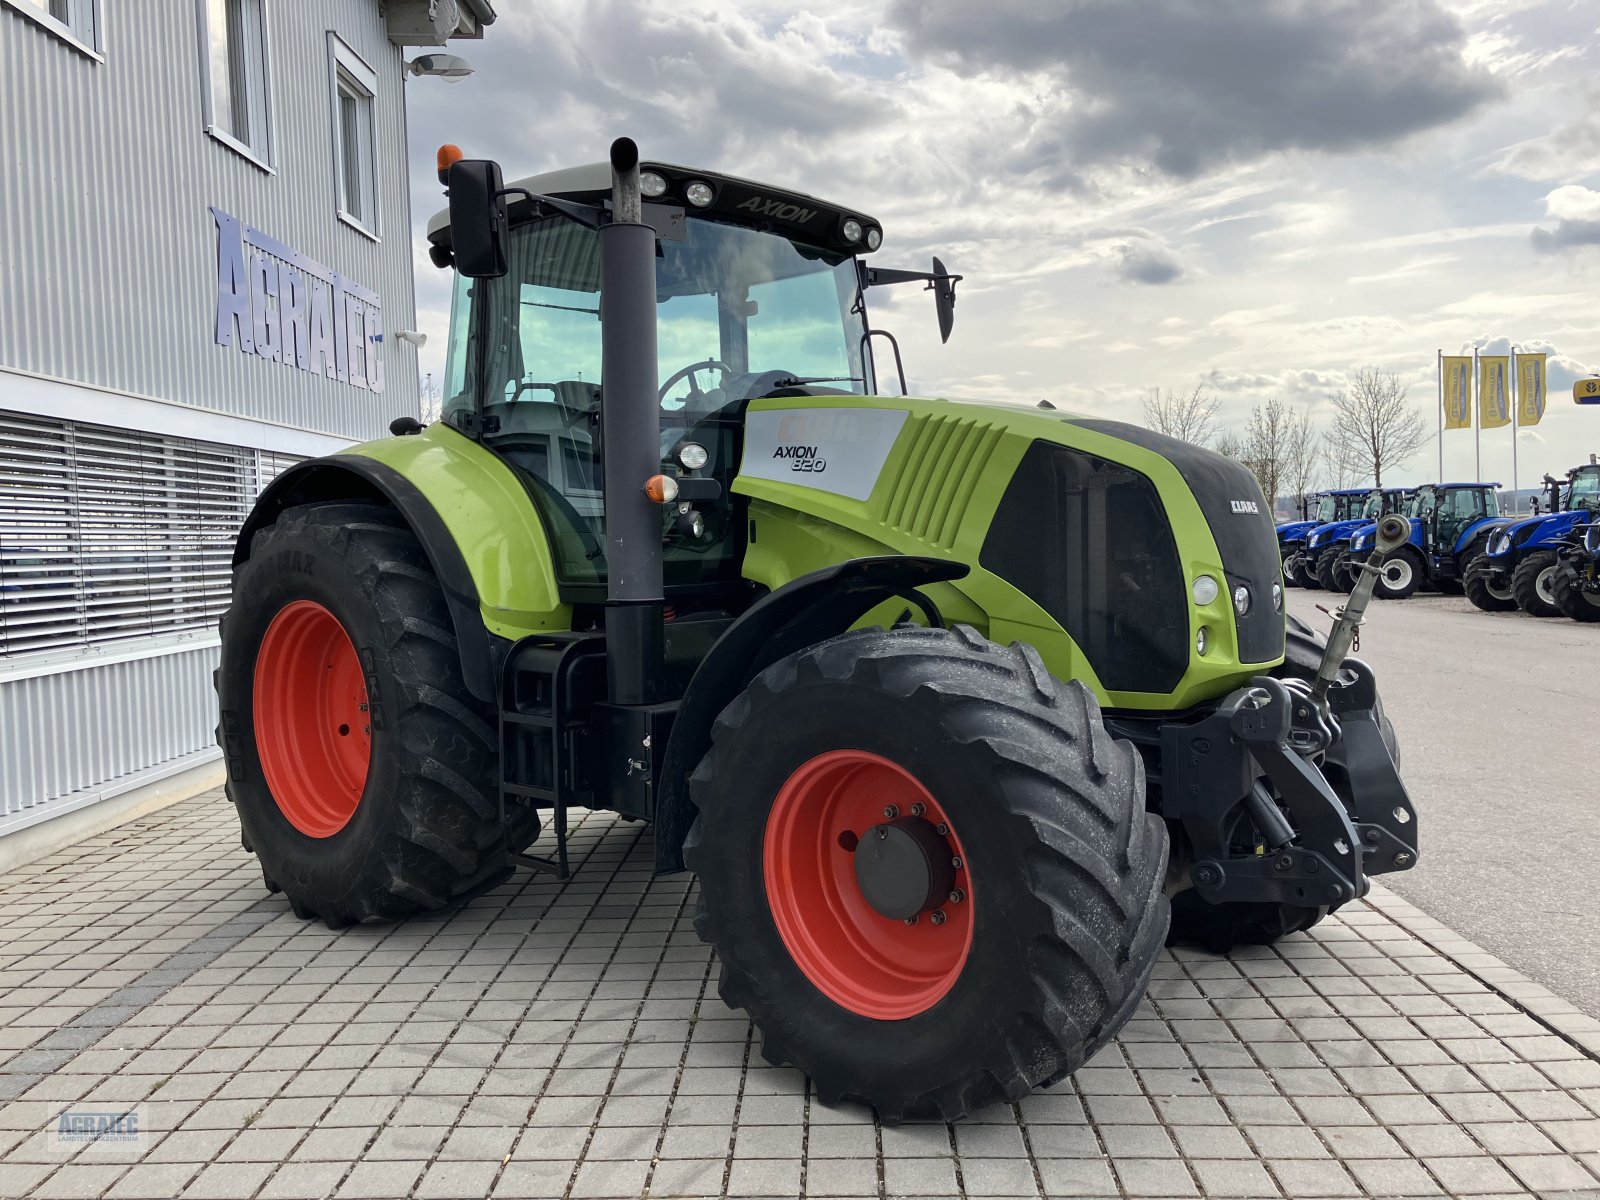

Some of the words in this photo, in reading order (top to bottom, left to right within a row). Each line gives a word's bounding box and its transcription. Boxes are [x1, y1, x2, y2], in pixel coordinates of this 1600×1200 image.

[736, 196, 817, 223] AXION
[208, 206, 384, 393] AGRATEC
[772, 445, 818, 459] AXION
[791, 457, 827, 472] 820
[1230, 500, 1259, 515] CLAAS
